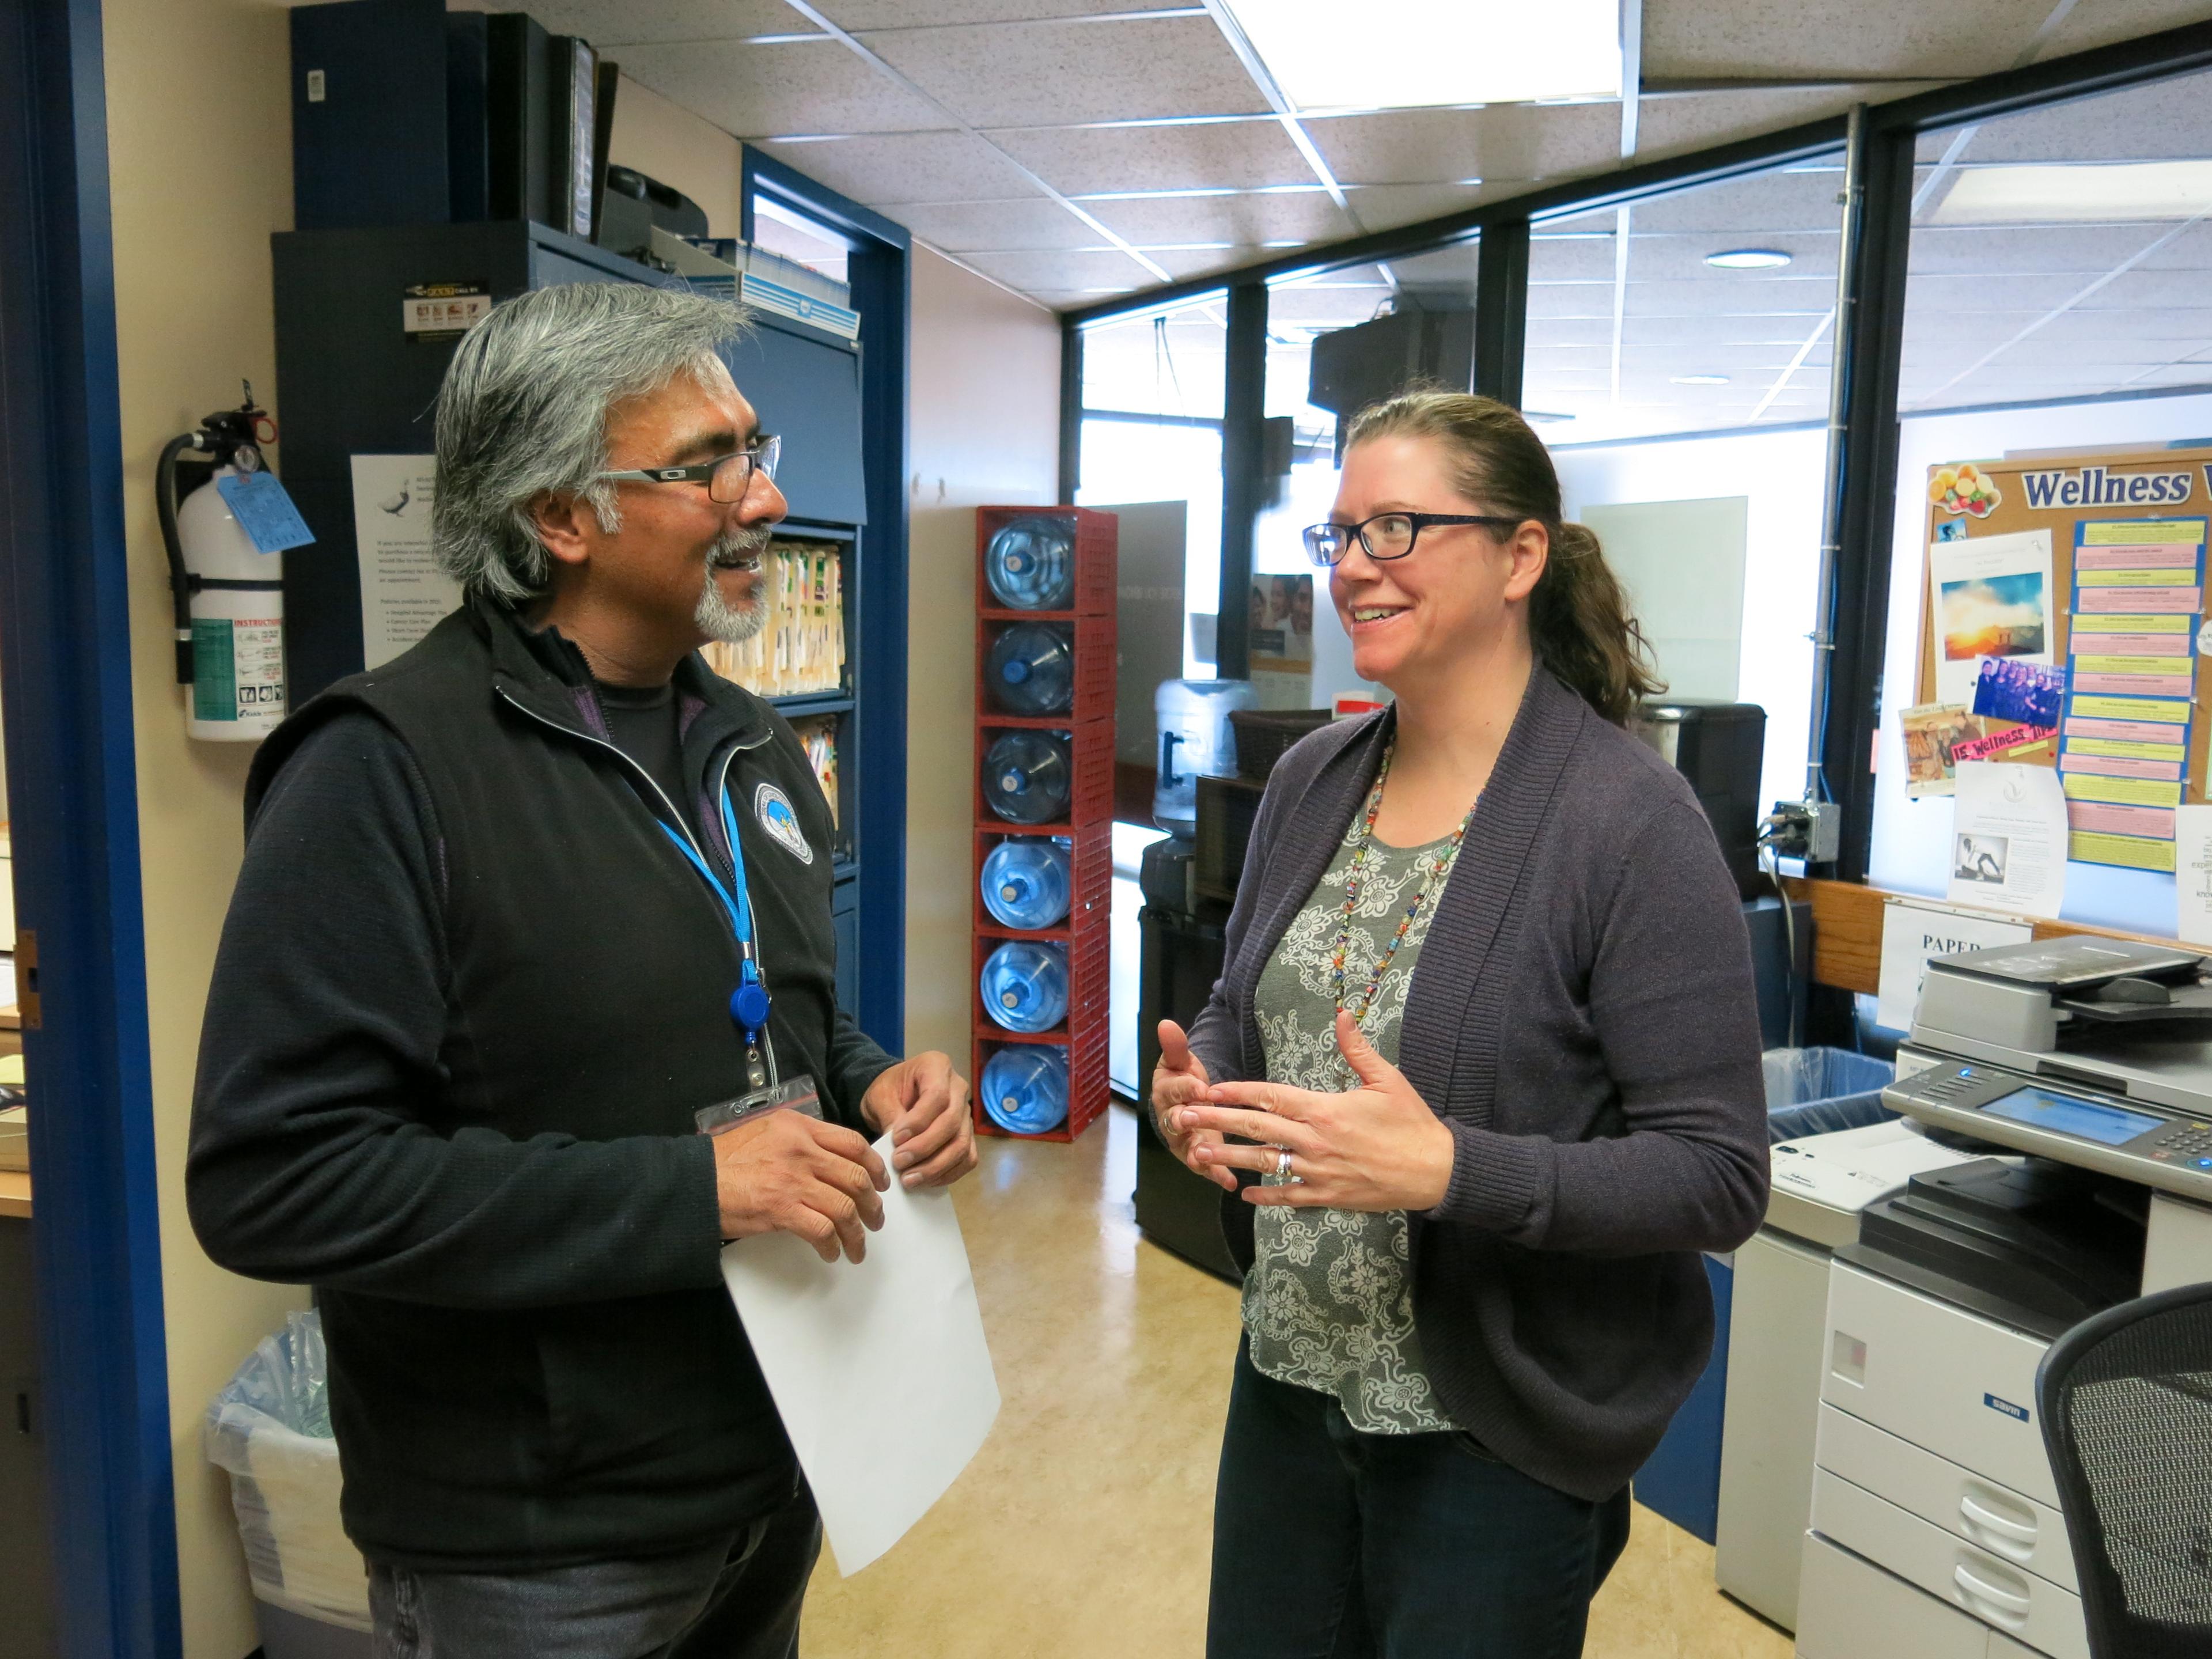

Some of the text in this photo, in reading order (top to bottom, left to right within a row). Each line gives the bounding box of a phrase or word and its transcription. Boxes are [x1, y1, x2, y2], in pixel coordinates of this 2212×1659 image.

[2024, 469, 2190, 507] Wellness
[1972, 729, 2025, 756] Wellness
[1993, 1399, 2020, 1417] savin
